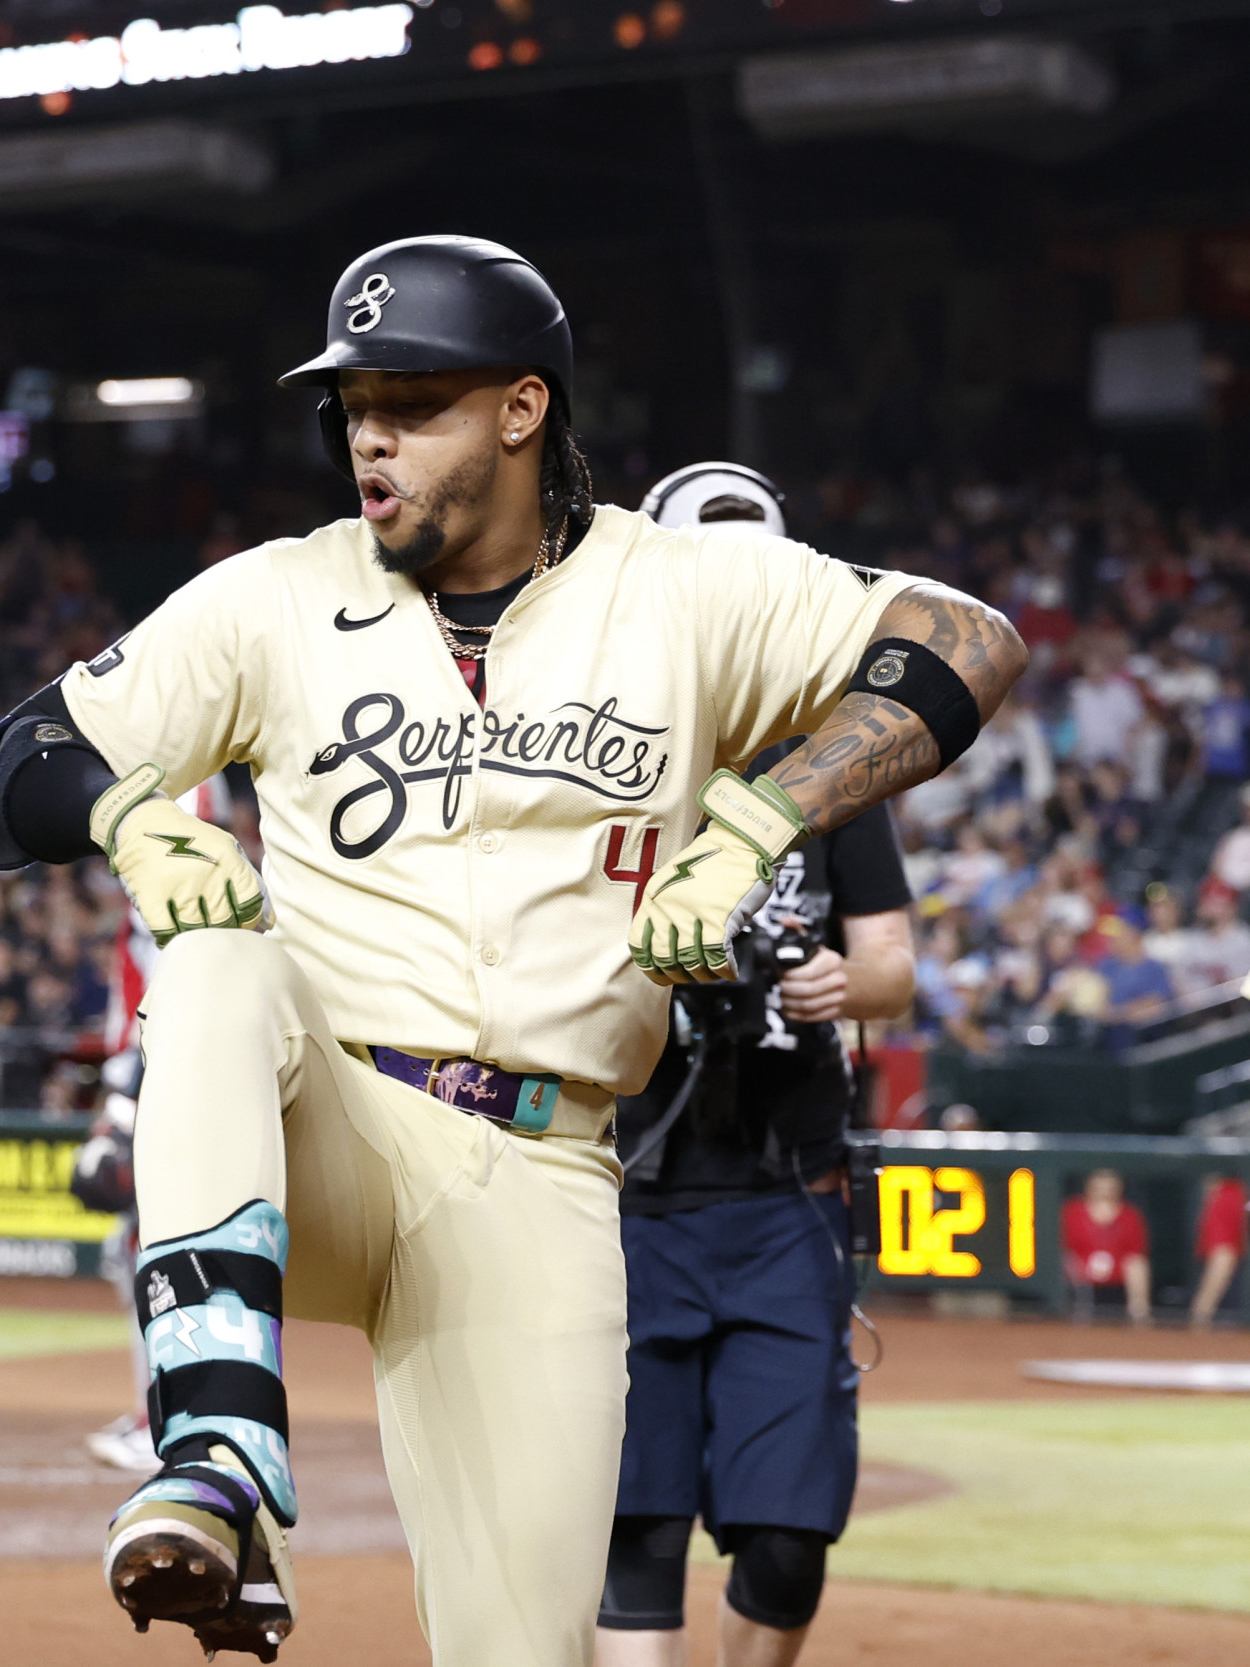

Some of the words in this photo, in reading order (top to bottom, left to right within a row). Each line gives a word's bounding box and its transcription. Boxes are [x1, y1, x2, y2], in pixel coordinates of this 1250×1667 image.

[306, 692, 669, 860] Serpientes
[602, 824, 661, 918] 4
[529, 1081, 545, 1111] 4
